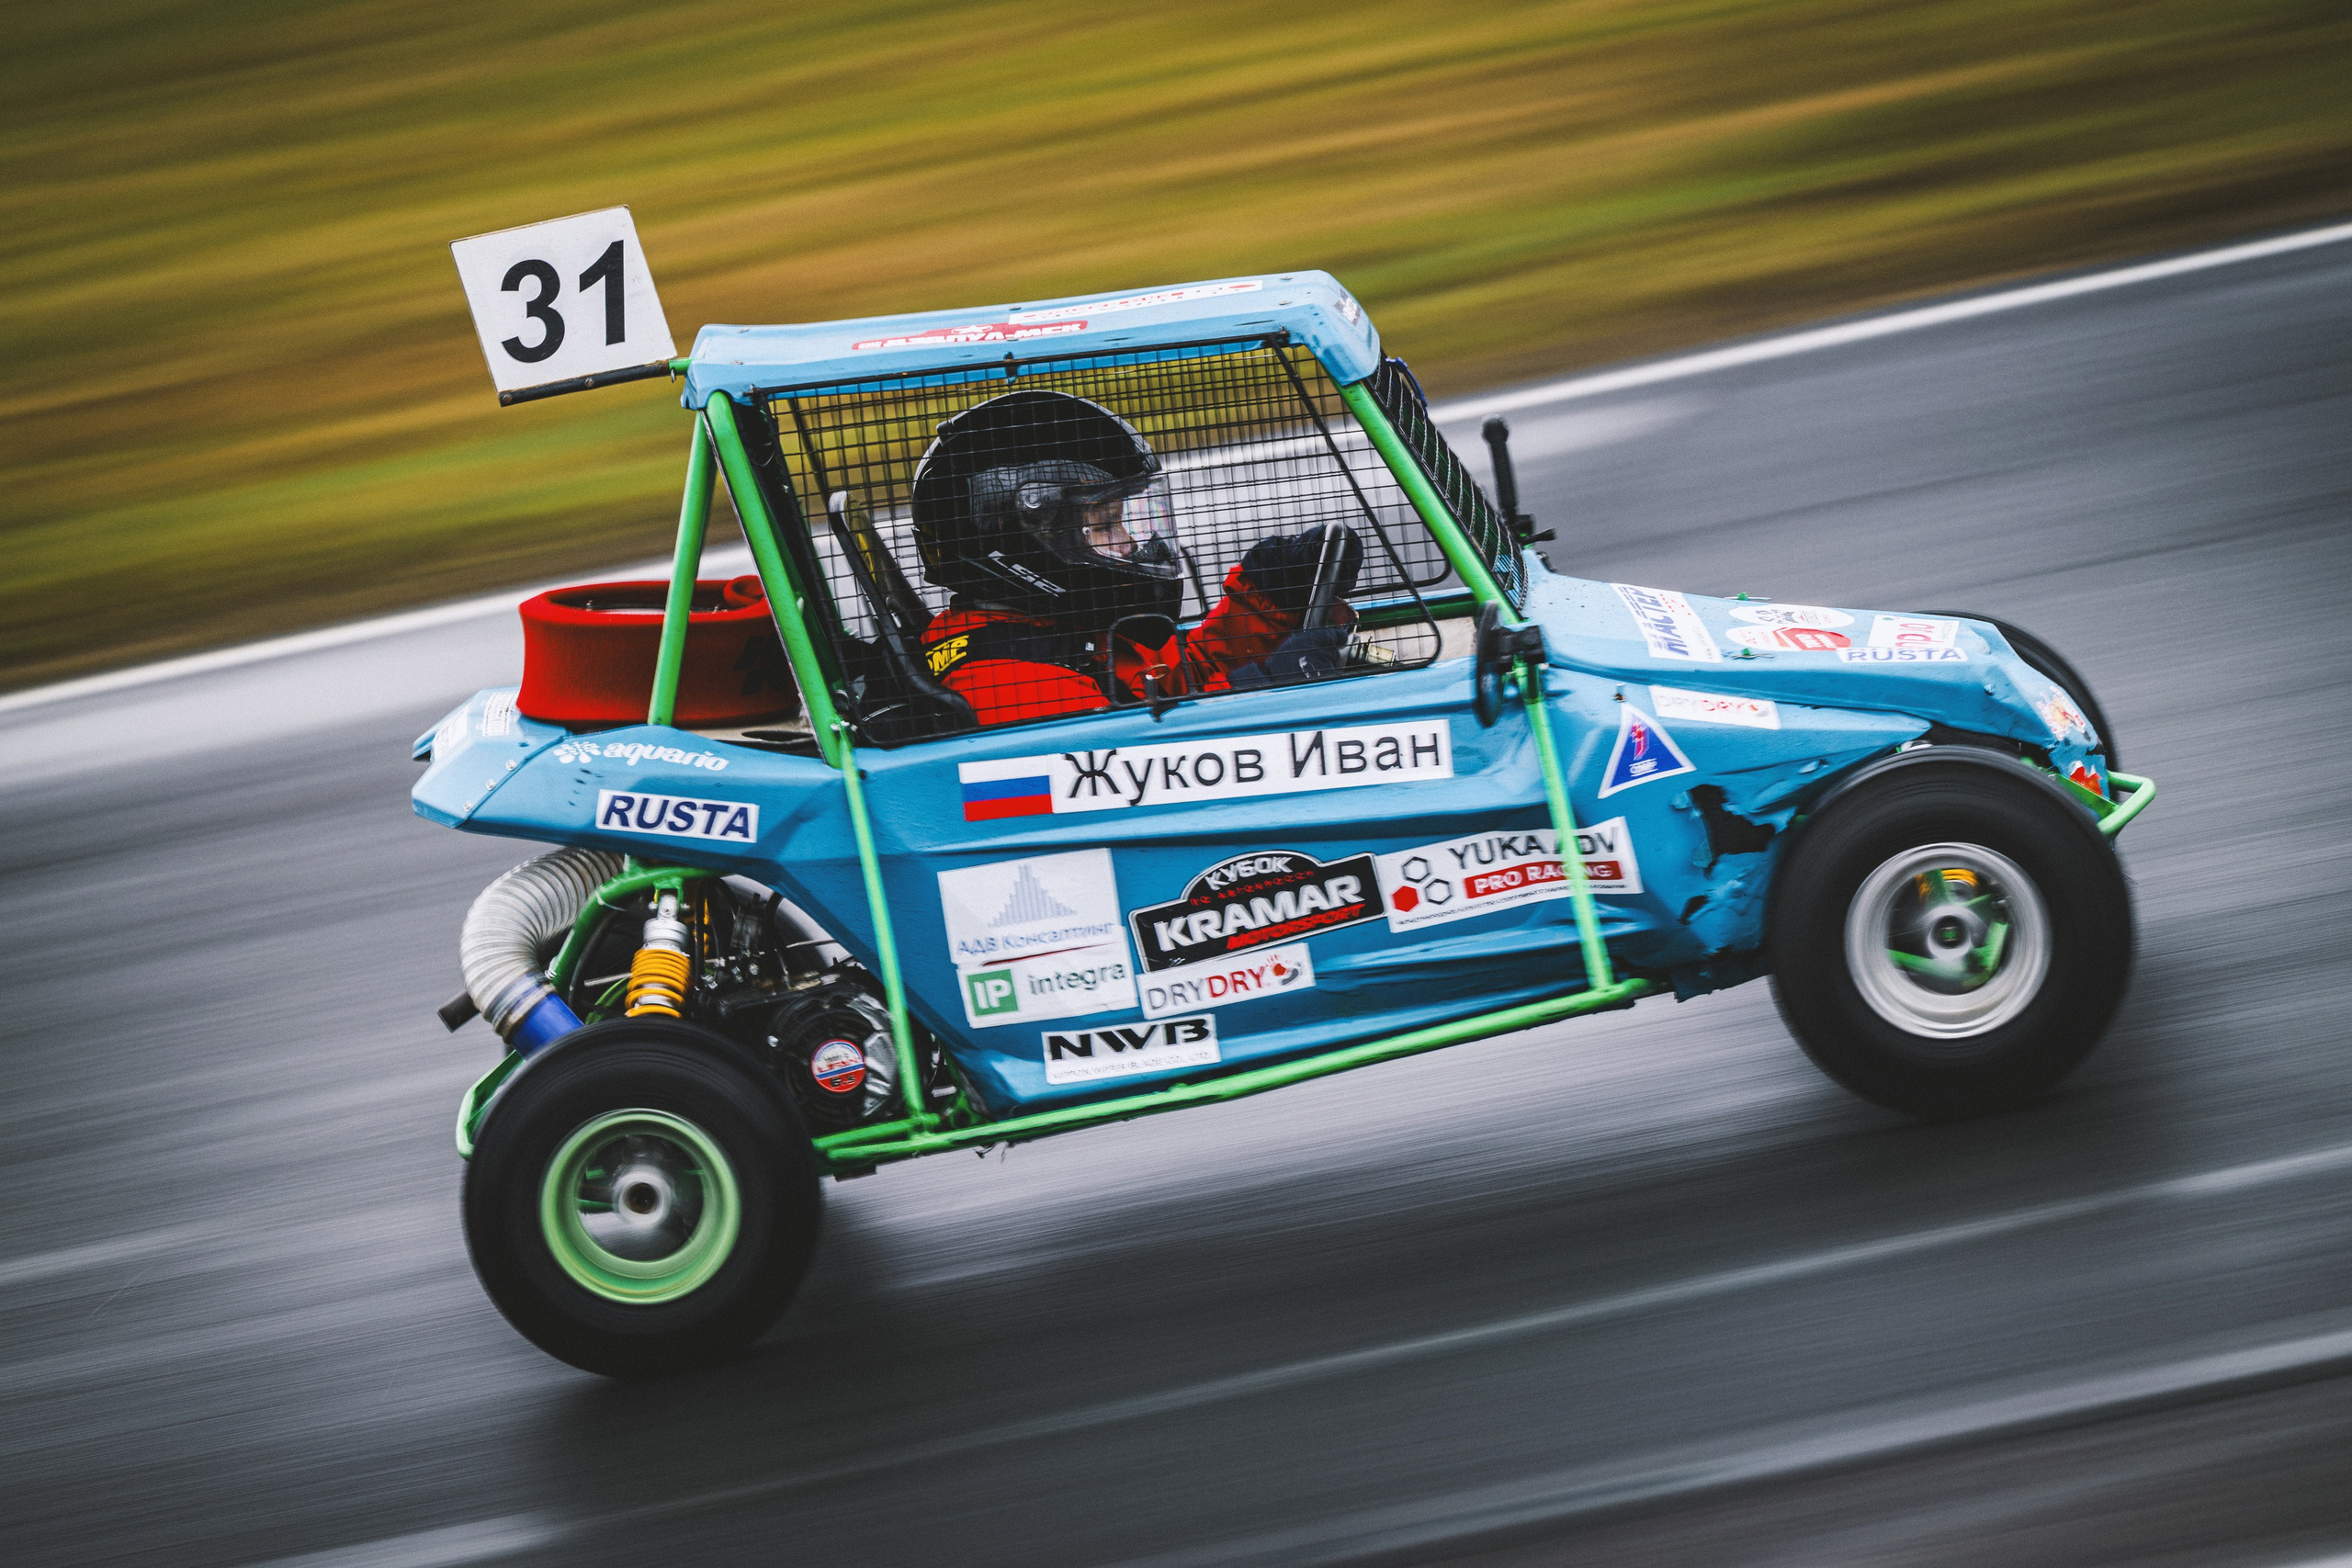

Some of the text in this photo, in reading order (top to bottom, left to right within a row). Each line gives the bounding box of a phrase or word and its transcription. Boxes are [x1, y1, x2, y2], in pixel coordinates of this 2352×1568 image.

[501, 241, 625, 363] 31
[1847, 648, 1962, 661] RUSTA
[603, 742, 729, 771] aquario
[1066, 731, 1441, 806] Жуков Иван
[602, 795, 750, 838] RUSTA
[1204, 856, 1294, 891] КУБОК
[1474, 871, 1523, 894] PRO
[1154, 874, 1365, 952] KRAMAR
[1226, 903, 1366, 950] MOTORSPORT
[973, 964, 1125, 1010] IP integra
[1146, 968, 1265, 1010] DRYDRY
[1048, 1019, 1209, 1060] NWB
